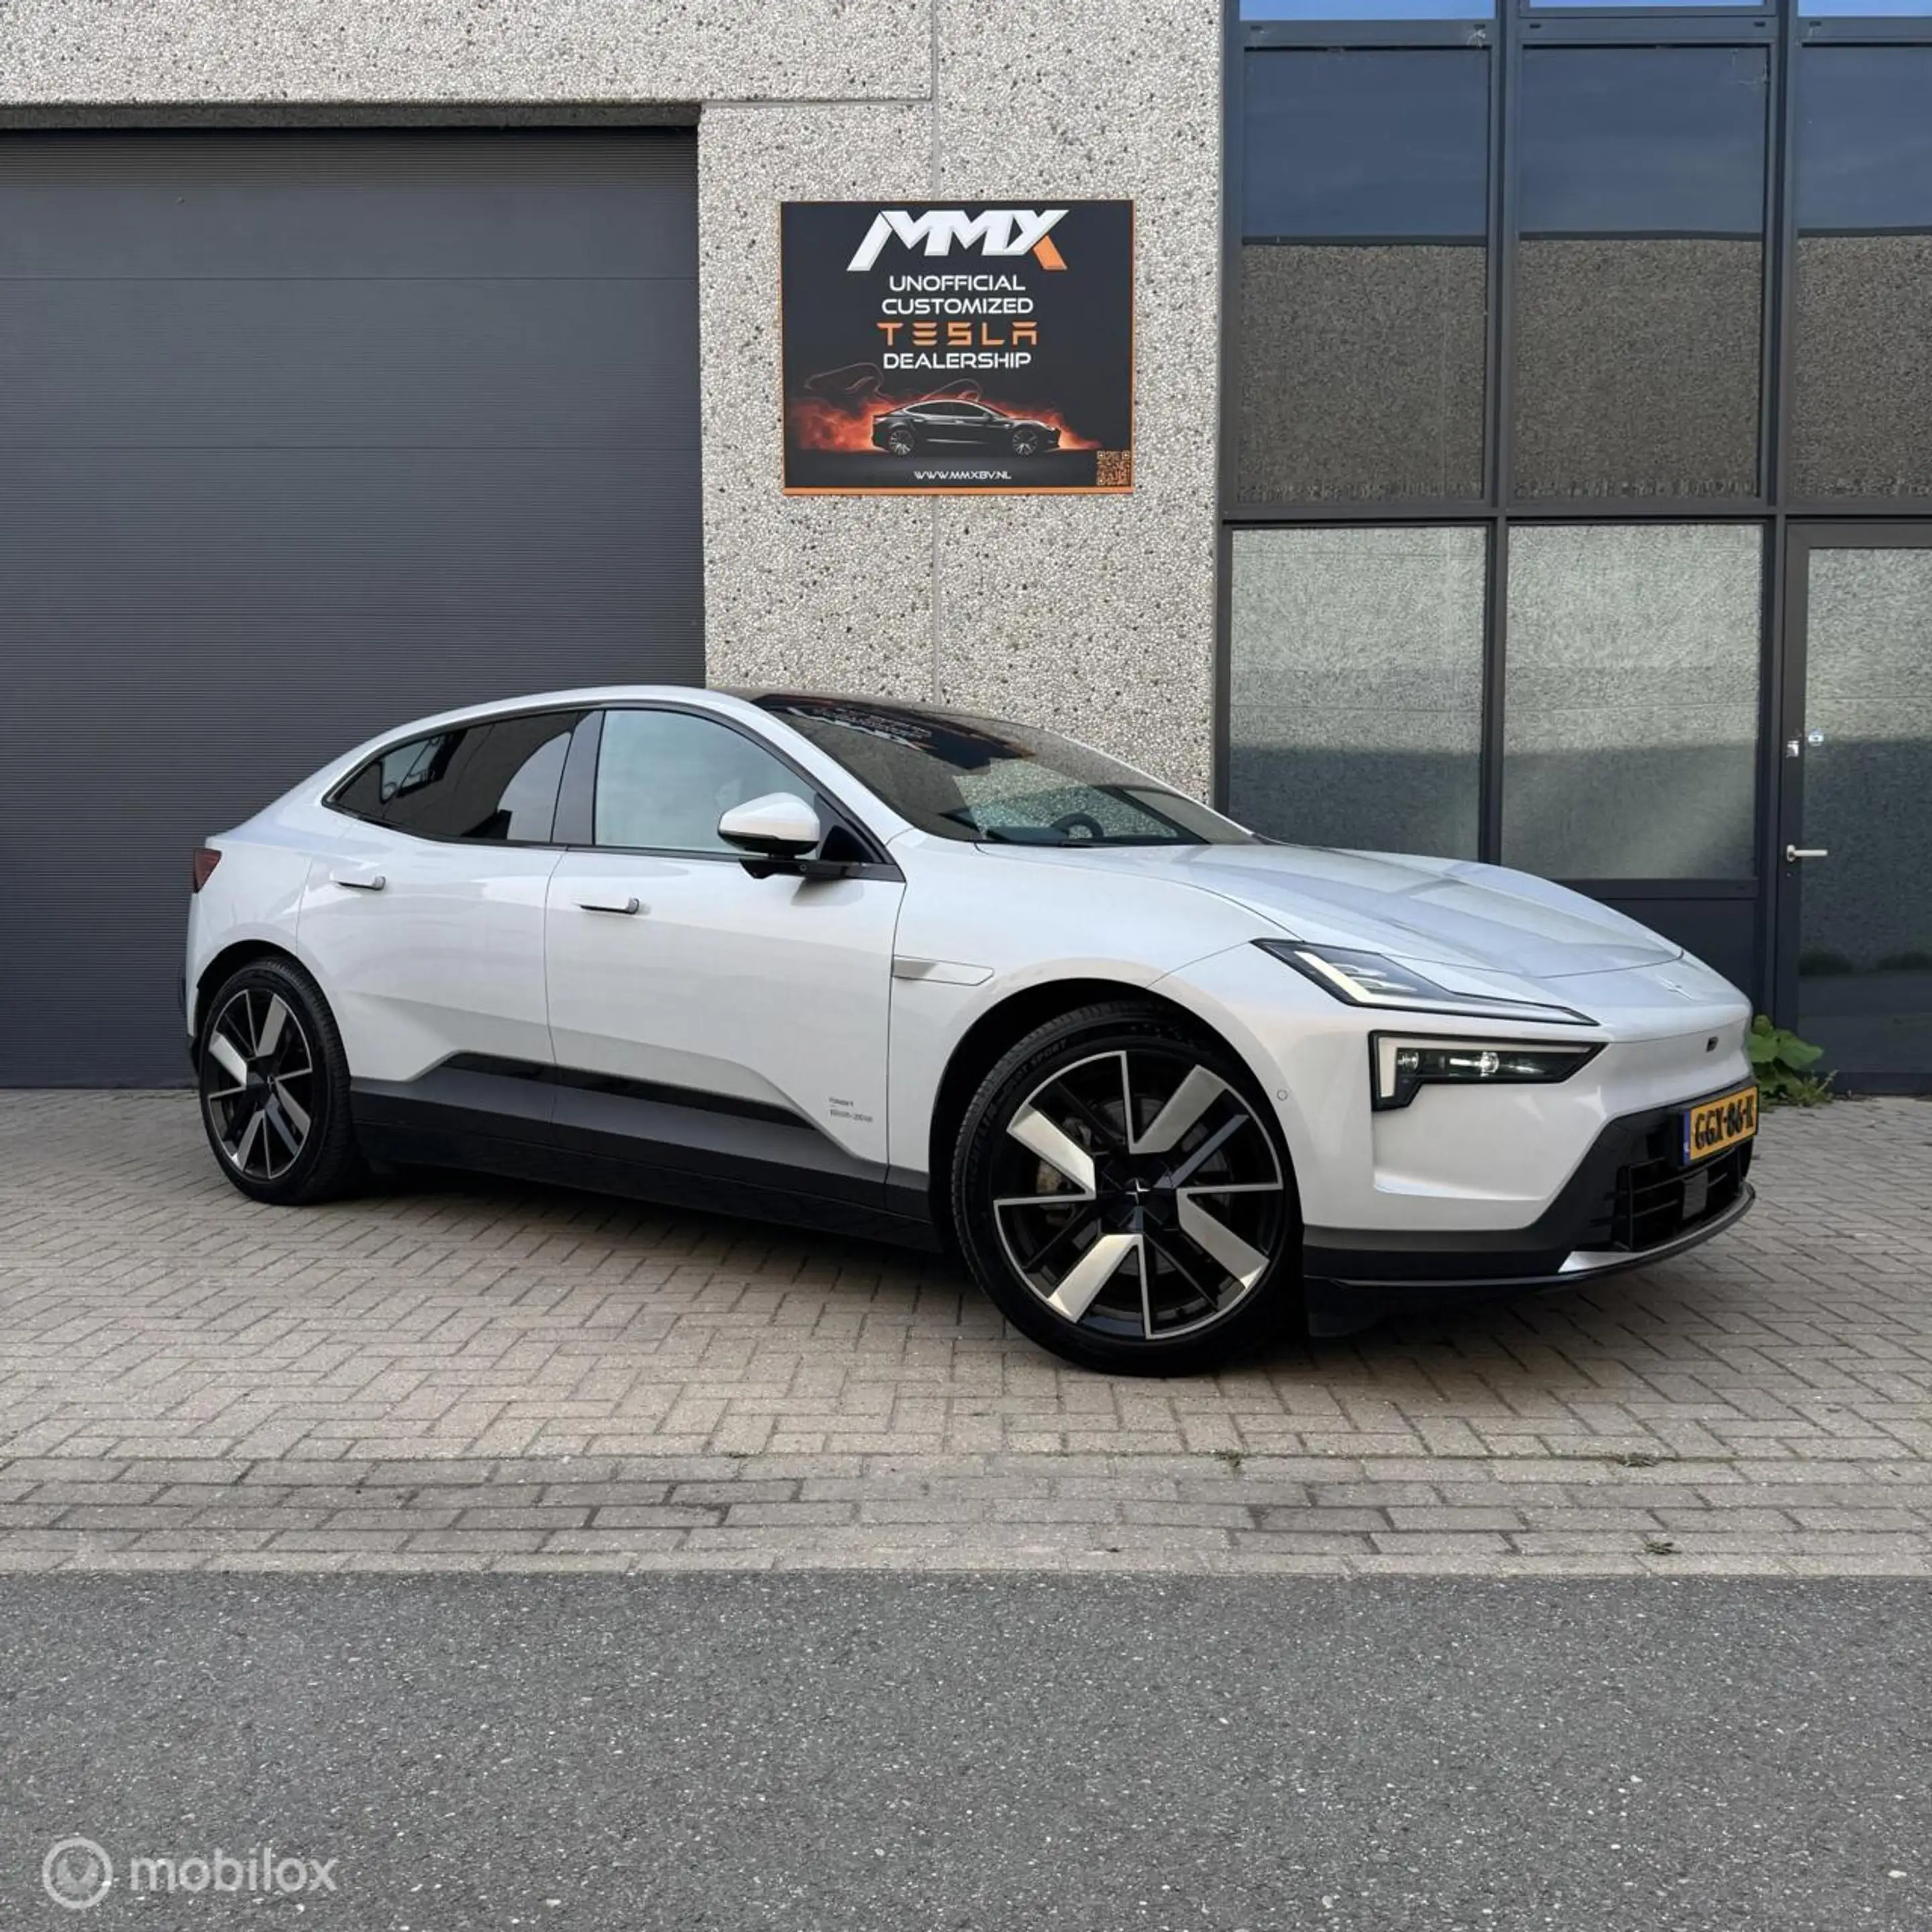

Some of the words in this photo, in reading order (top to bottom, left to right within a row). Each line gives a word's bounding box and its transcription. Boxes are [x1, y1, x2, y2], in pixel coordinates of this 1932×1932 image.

[846, 209, 1069, 271] MMX
[889, 274, 1026, 292] UNOFFICIAL
[881, 297, 1034, 315] CUSTOMIZED
[876, 321, 1037, 347] TESLA
[883, 352, 1032, 370] DEALERSHIP
[914, 470, 1012, 480] WWW.MMXBV.NL
